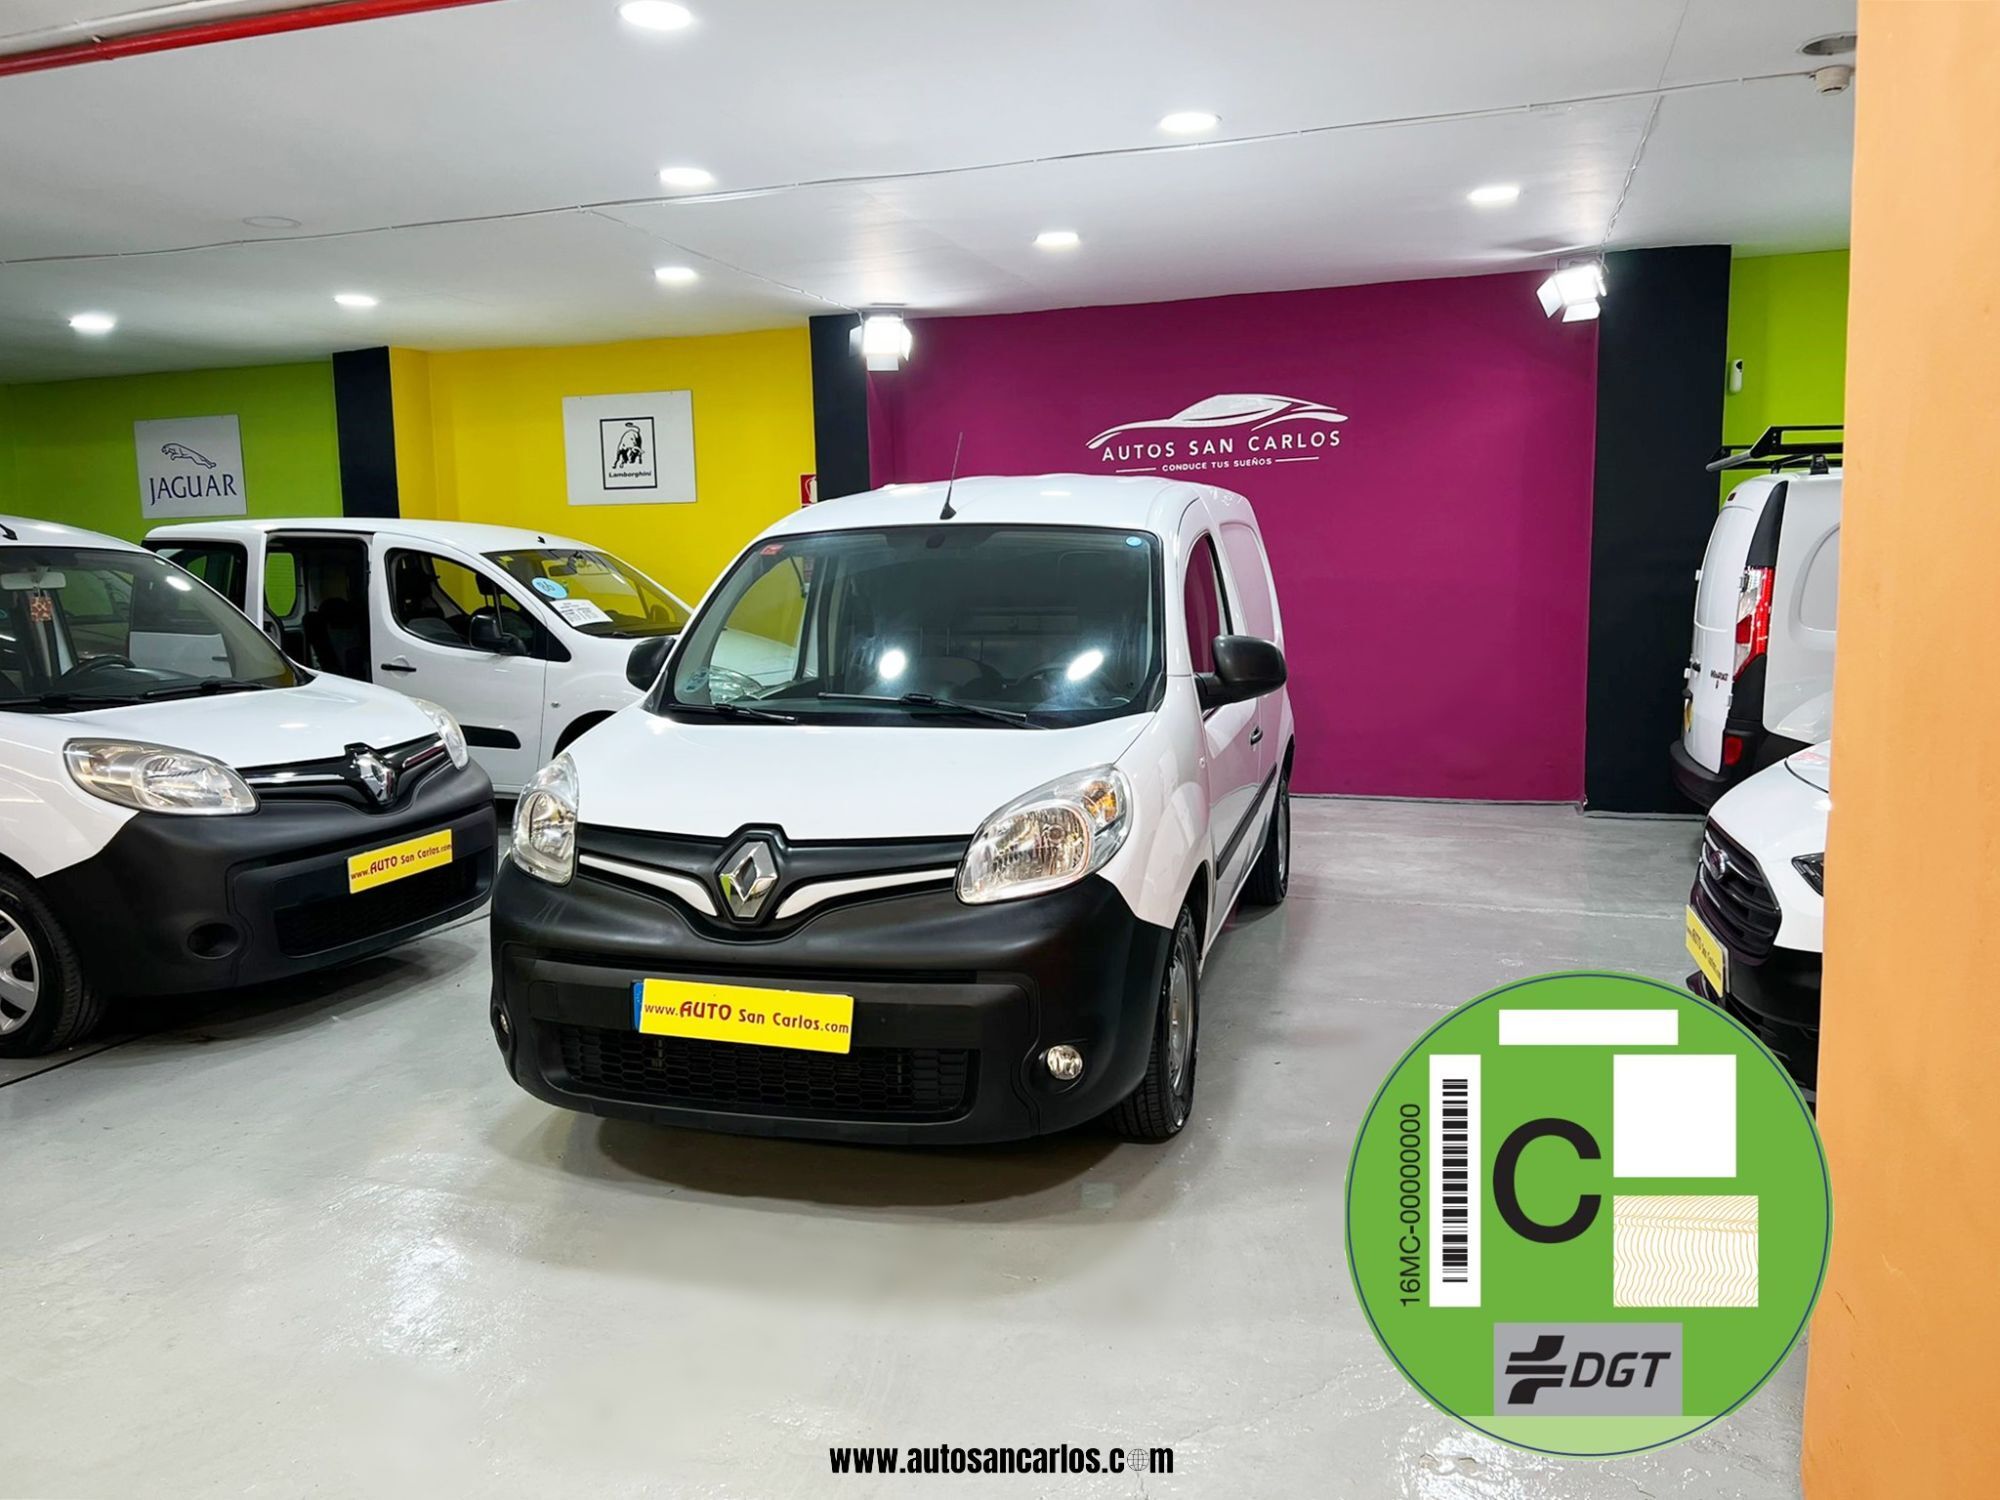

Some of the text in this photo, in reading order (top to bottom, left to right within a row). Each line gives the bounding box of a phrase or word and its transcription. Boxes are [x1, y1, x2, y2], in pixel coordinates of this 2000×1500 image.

[1102, 430, 1341, 462] AUTOS SAN CARLOS
[1162, 457, 1272, 472] CONDUCE TUS SUEÑOS
[149, 474, 237, 505] JAGUAR
[738, 1008, 765, 1025] San
[772, 1012, 849, 1034] Carlos.com
